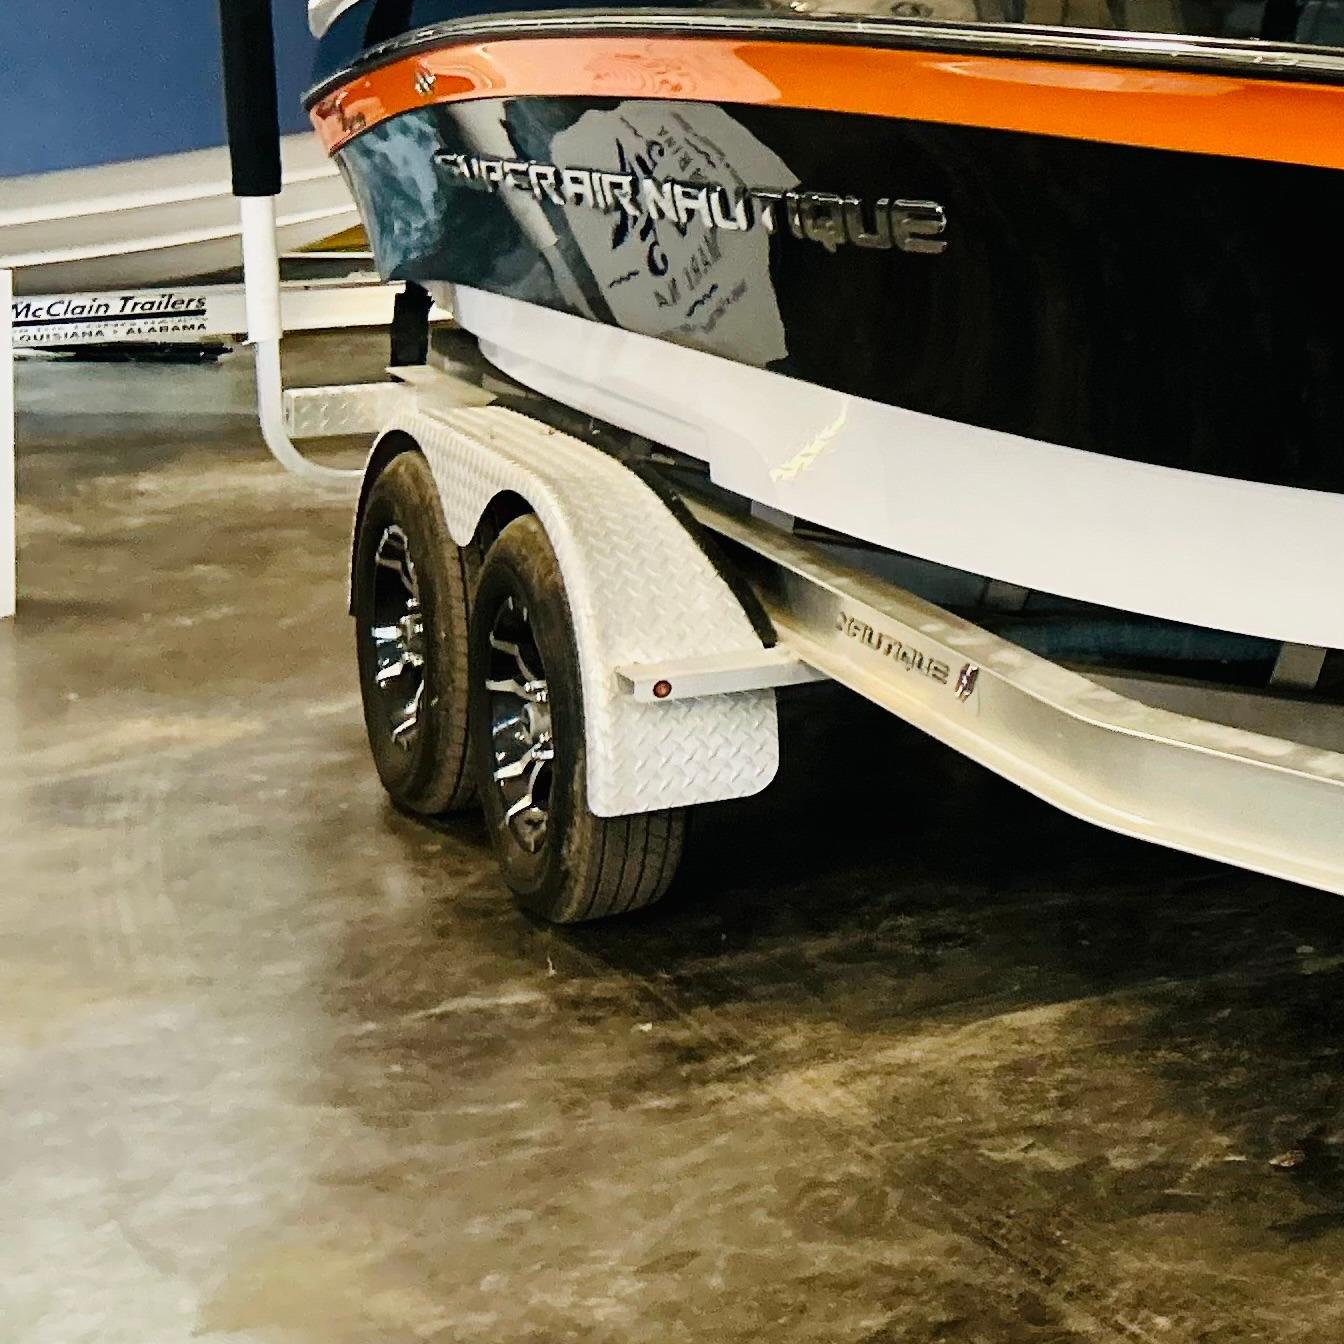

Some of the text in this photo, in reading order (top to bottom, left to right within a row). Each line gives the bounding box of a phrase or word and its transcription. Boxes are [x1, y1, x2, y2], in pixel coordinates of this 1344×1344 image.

[562, 167, 643, 216] AIR
[642, 175, 948, 254] NAUTIQUE
[119, 294, 208, 315] Trailers
